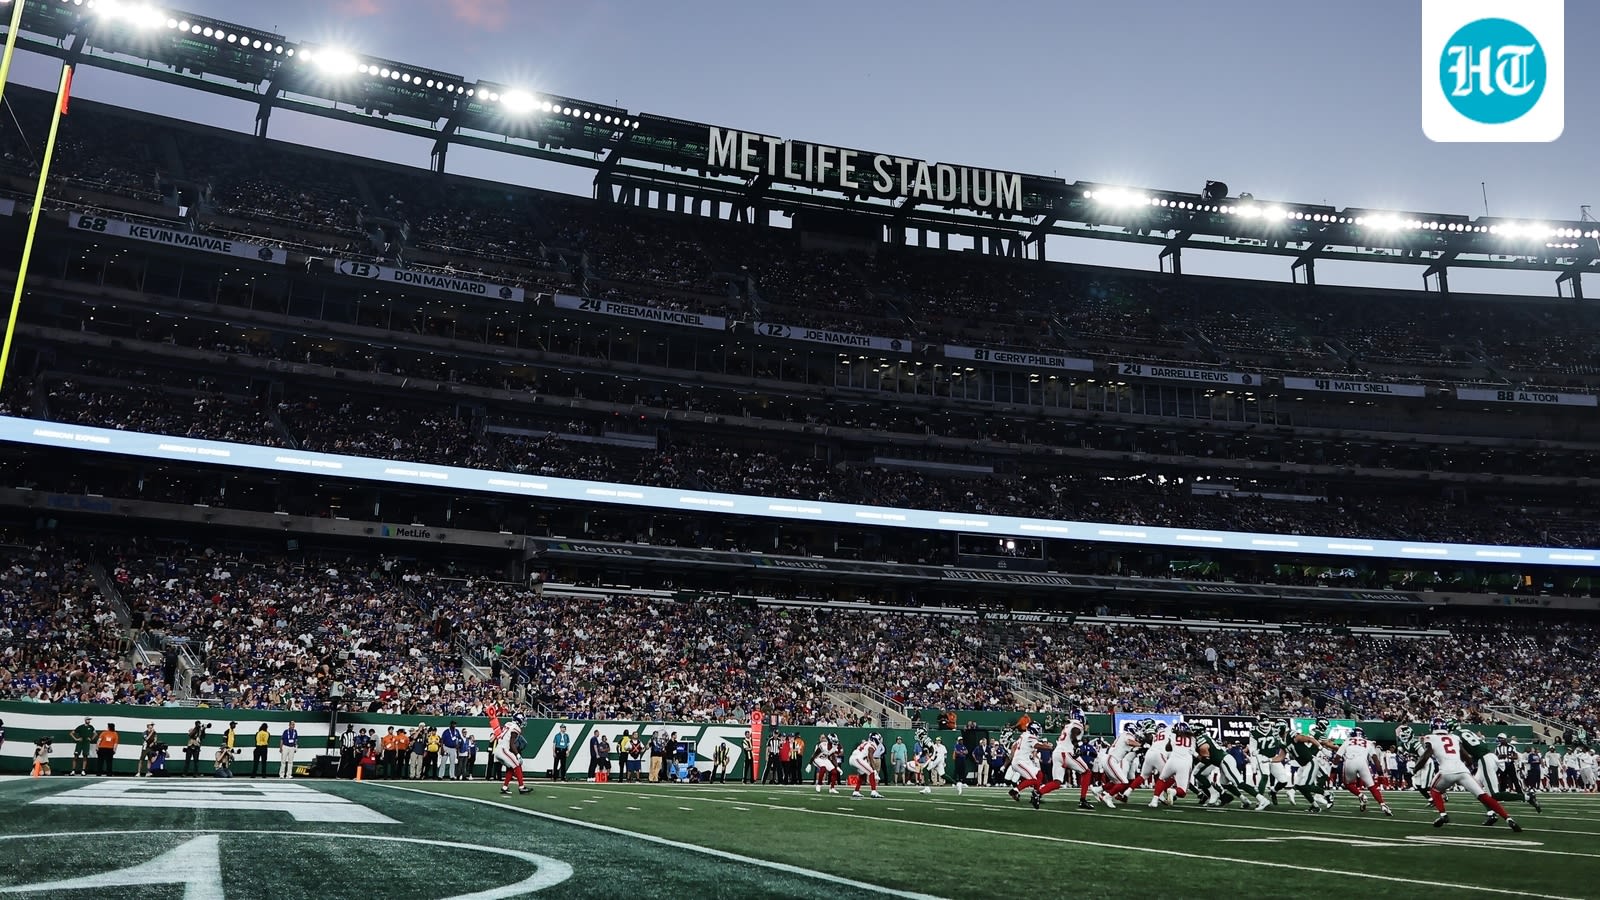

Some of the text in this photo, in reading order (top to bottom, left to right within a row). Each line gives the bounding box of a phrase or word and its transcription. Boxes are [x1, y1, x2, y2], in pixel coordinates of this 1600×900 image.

[707, 126, 1022, 211] METLIFE STADIUM
[77, 215, 232, 253] 68 KEVIN MAWAE
[351, 261, 486, 294] 13 DON MAYNARD
[578, 298, 704, 325] 24 FREEMAN MCNEIL
[767, 324, 870, 347] 12 JOE NAMATH
[974, 349, 1065, 367] 81 GERRY PHILBIN
[1123, 364, 1229, 382] 24 DARRELLE REVIS
[1334, 382, 1362, 392] MATT
[1364, 383, 1392, 394] SNELL
[1518, 392, 1530, 401] AL
[1530, 393, 1559, 403] TOON
[396, 527, 431, 539] MetLife
[573, 544, 633, 556] MetLife
[774, 559, 828, 570] MetLife
[943, 570, 1073, 585] METLIFE STADIUM
[984, 612, 1010, 620] NEW
[1011, 614, 1042, 622] YORK
[1176, 733, 1192, 748] 90
[1258, 735, 1276, 750] 72
[1441, 736, 1457, 755] 2
